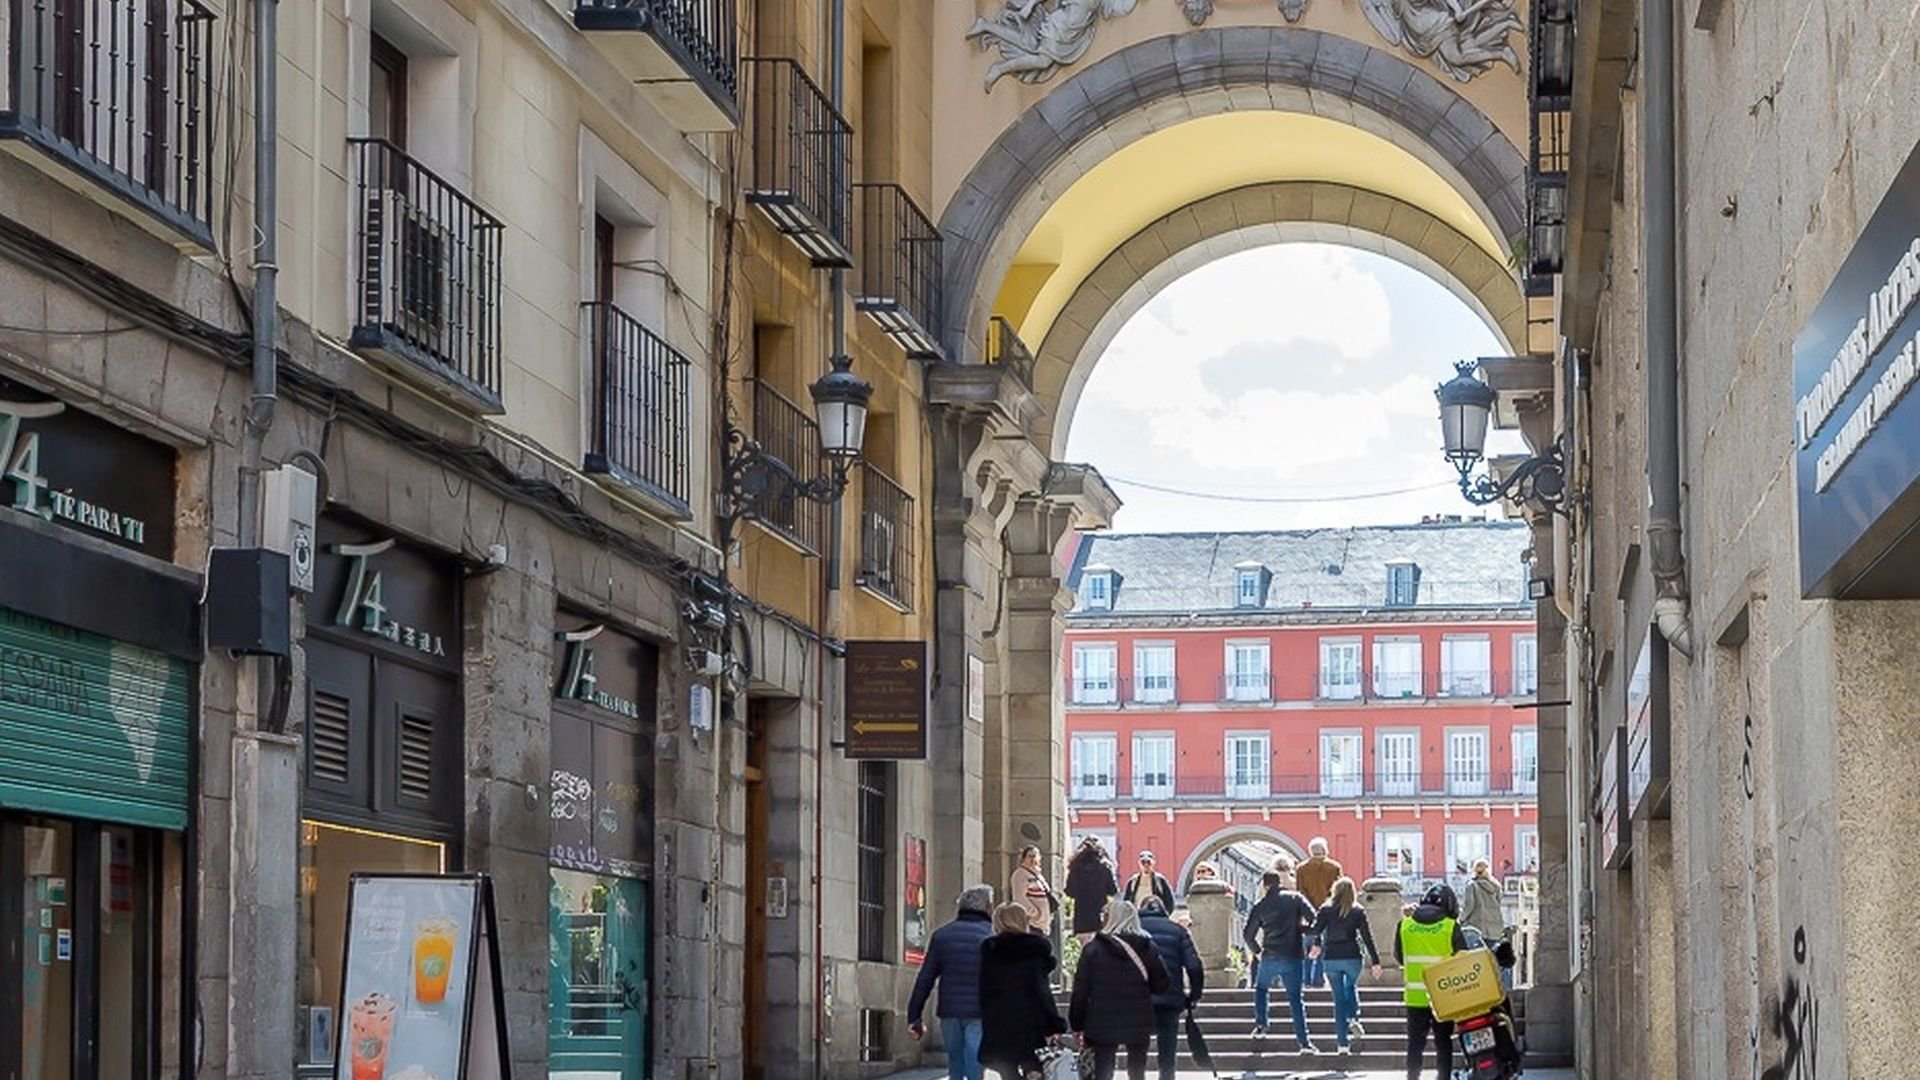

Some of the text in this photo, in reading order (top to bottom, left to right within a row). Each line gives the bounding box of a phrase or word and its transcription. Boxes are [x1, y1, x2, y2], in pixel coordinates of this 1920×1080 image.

[50, 488, 144, 543] TÉ PARA TI
[331, 538, 396, 633] T4
[1438, 963, 1482, 990] Glovo
